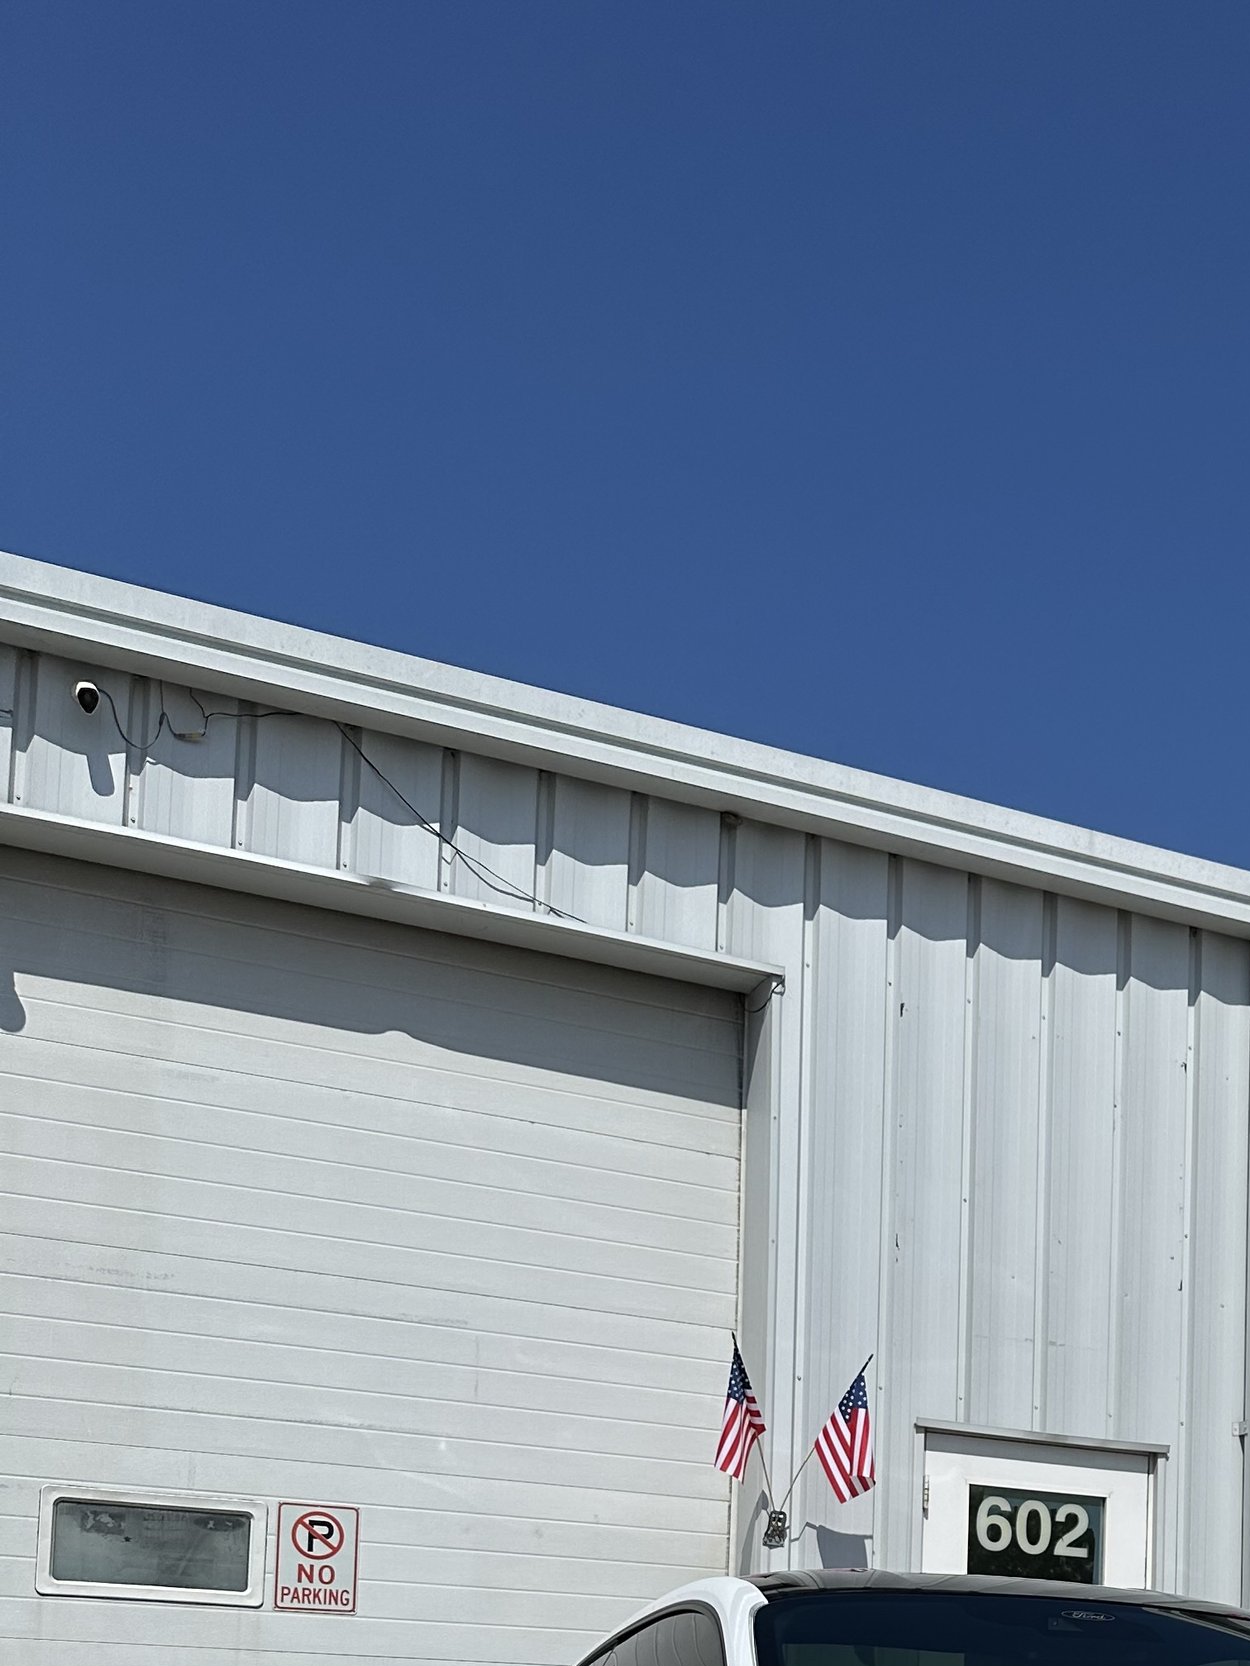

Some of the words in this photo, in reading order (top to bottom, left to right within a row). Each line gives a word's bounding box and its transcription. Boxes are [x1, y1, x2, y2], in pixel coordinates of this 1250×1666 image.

[976, 1495, 1089, 1558] 602
[297, 1563, 336, 1585] NO
[280, 1586, 350, 1607] PARKING
